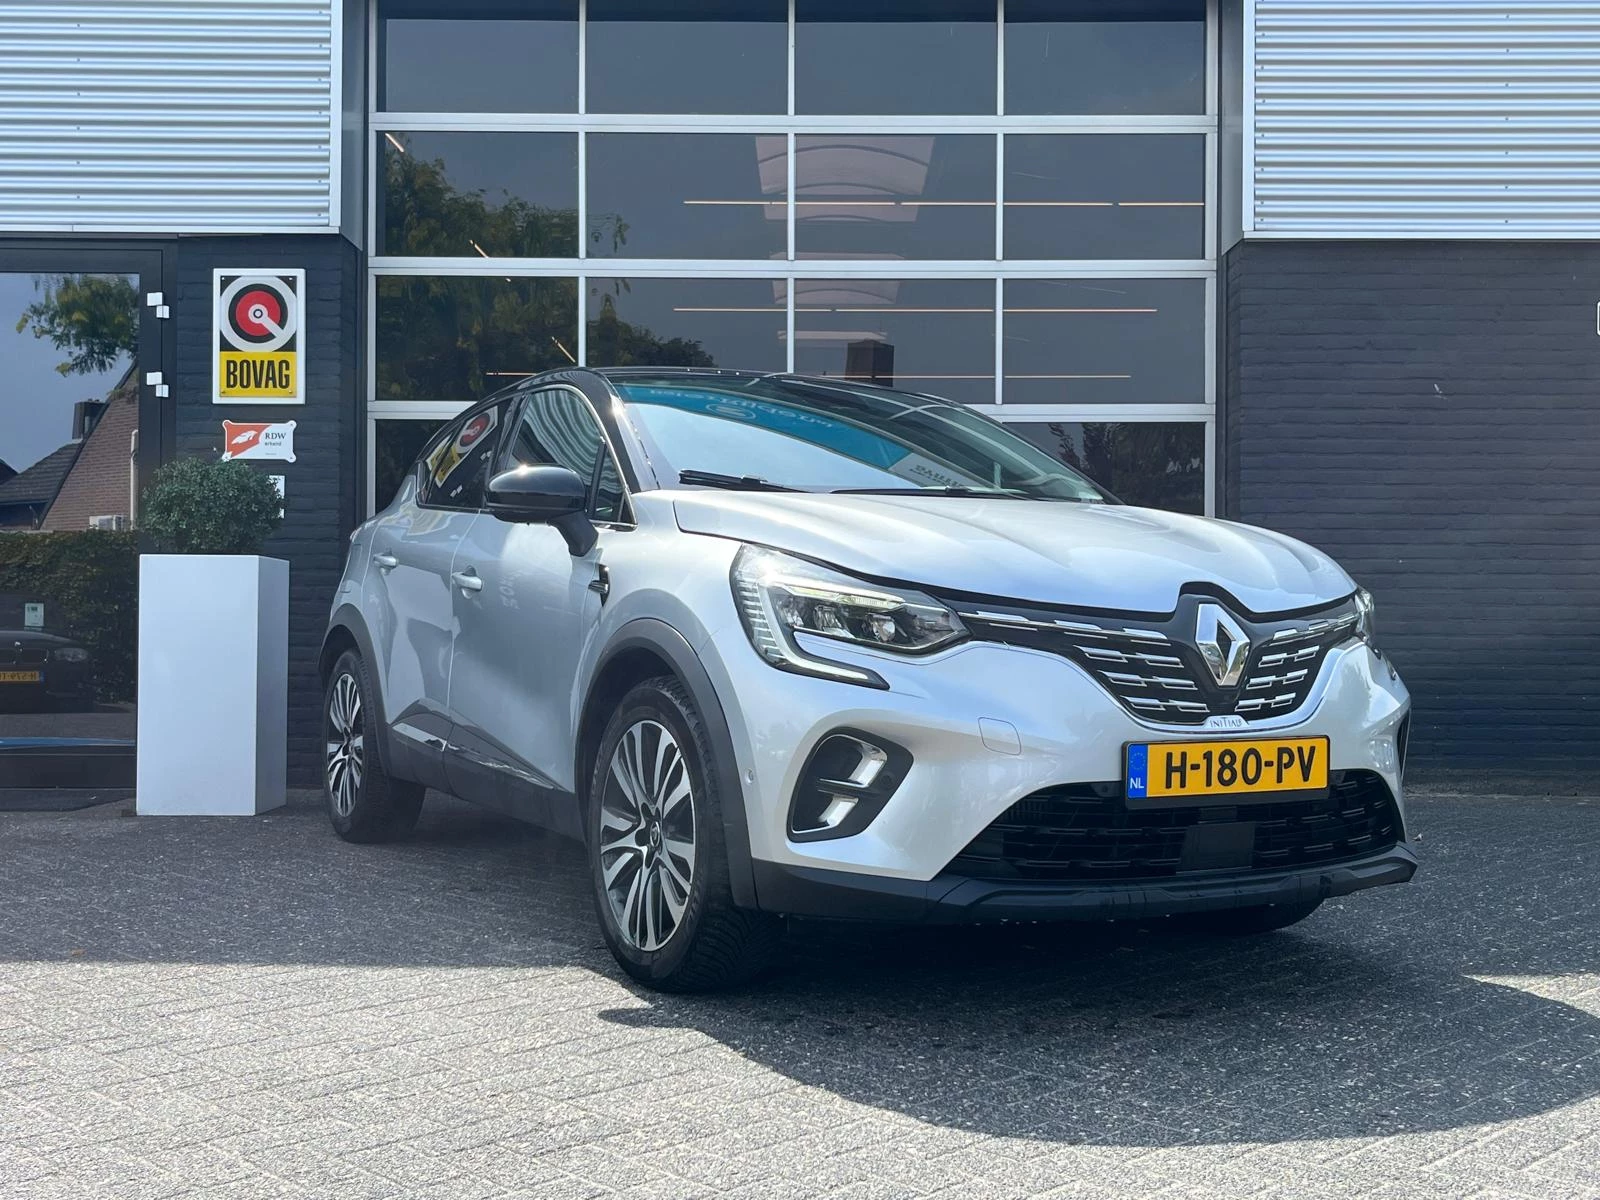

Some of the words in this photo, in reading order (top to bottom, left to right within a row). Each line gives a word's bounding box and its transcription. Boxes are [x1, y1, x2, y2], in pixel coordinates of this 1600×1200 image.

[226, 359, 290, 389] BOVAG
[265, 432, 287, 440] RDW
[1129, 777, 1145, 789] NL
[1165, 745, 1316, 789] H-180-PV
